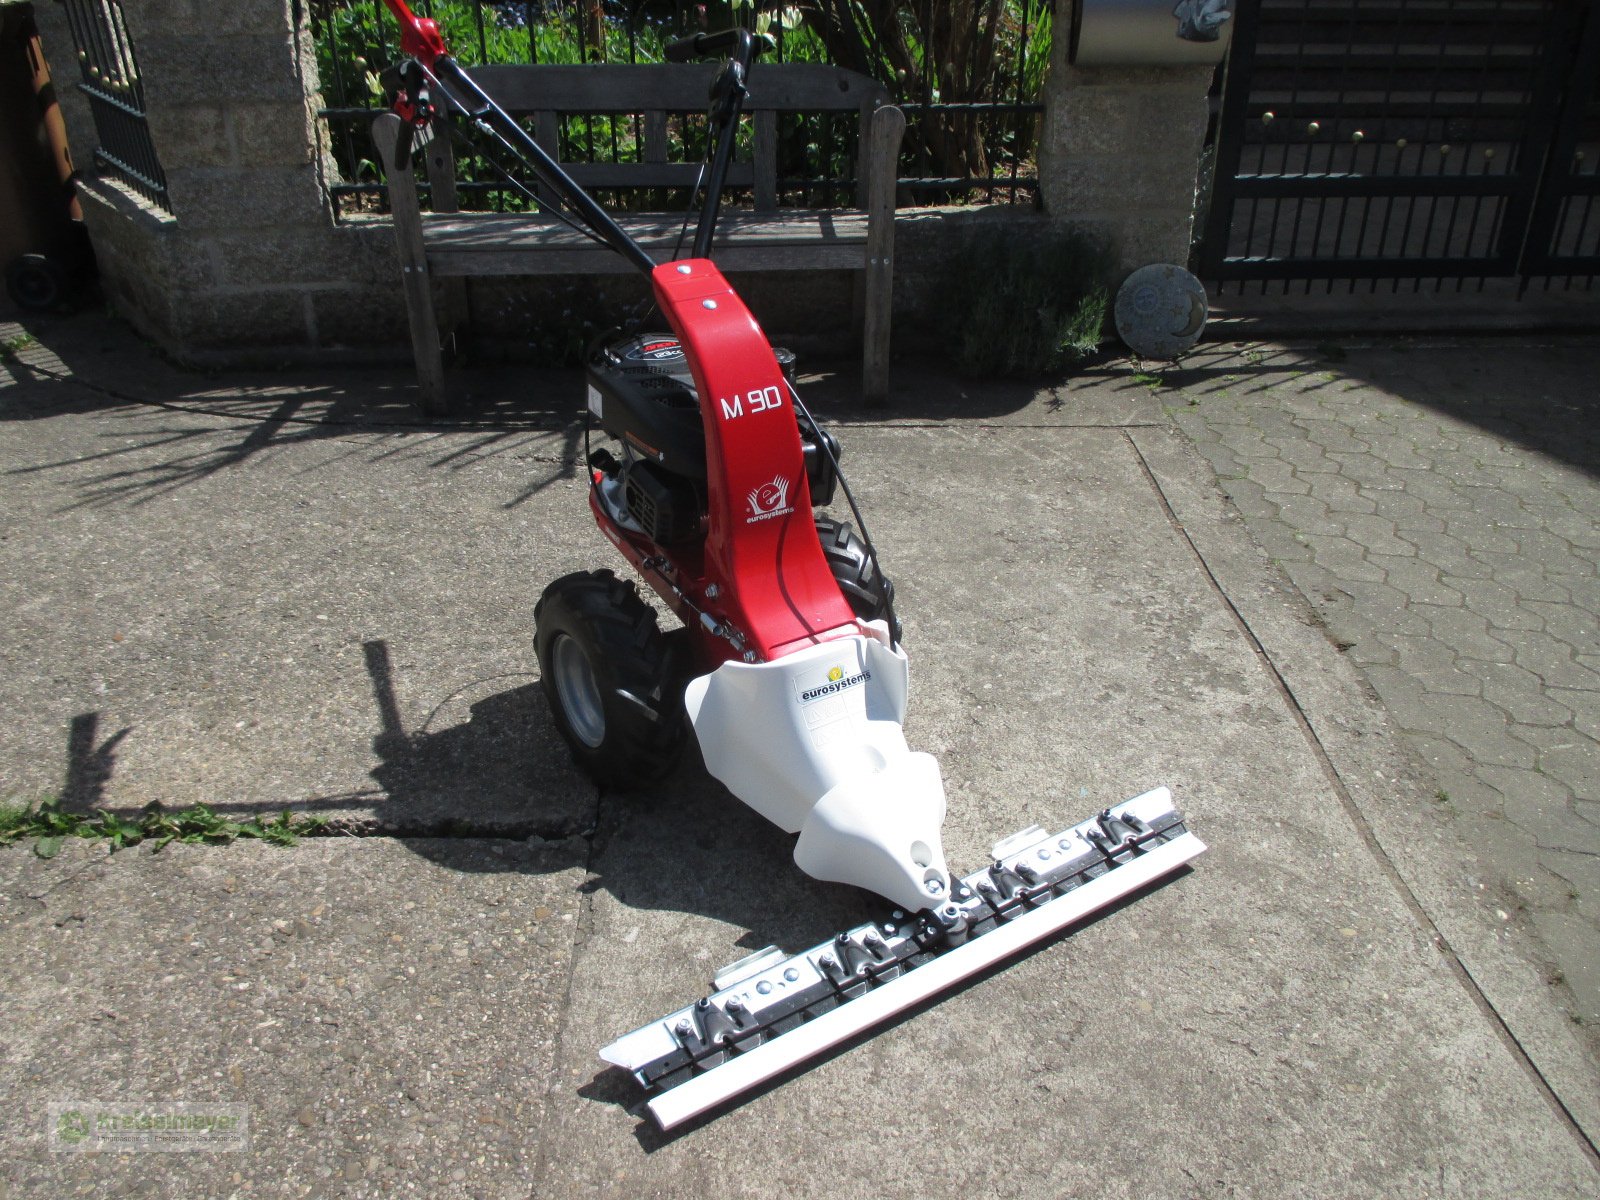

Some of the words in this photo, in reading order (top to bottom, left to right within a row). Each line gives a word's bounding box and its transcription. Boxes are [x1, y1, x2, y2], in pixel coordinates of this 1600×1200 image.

[720, 395, 744, 420] M
[747, 385, 782, 414] 90
[746, 507, 795, 524] eurosystems
[802, 671, 872, 700] eurosystems
